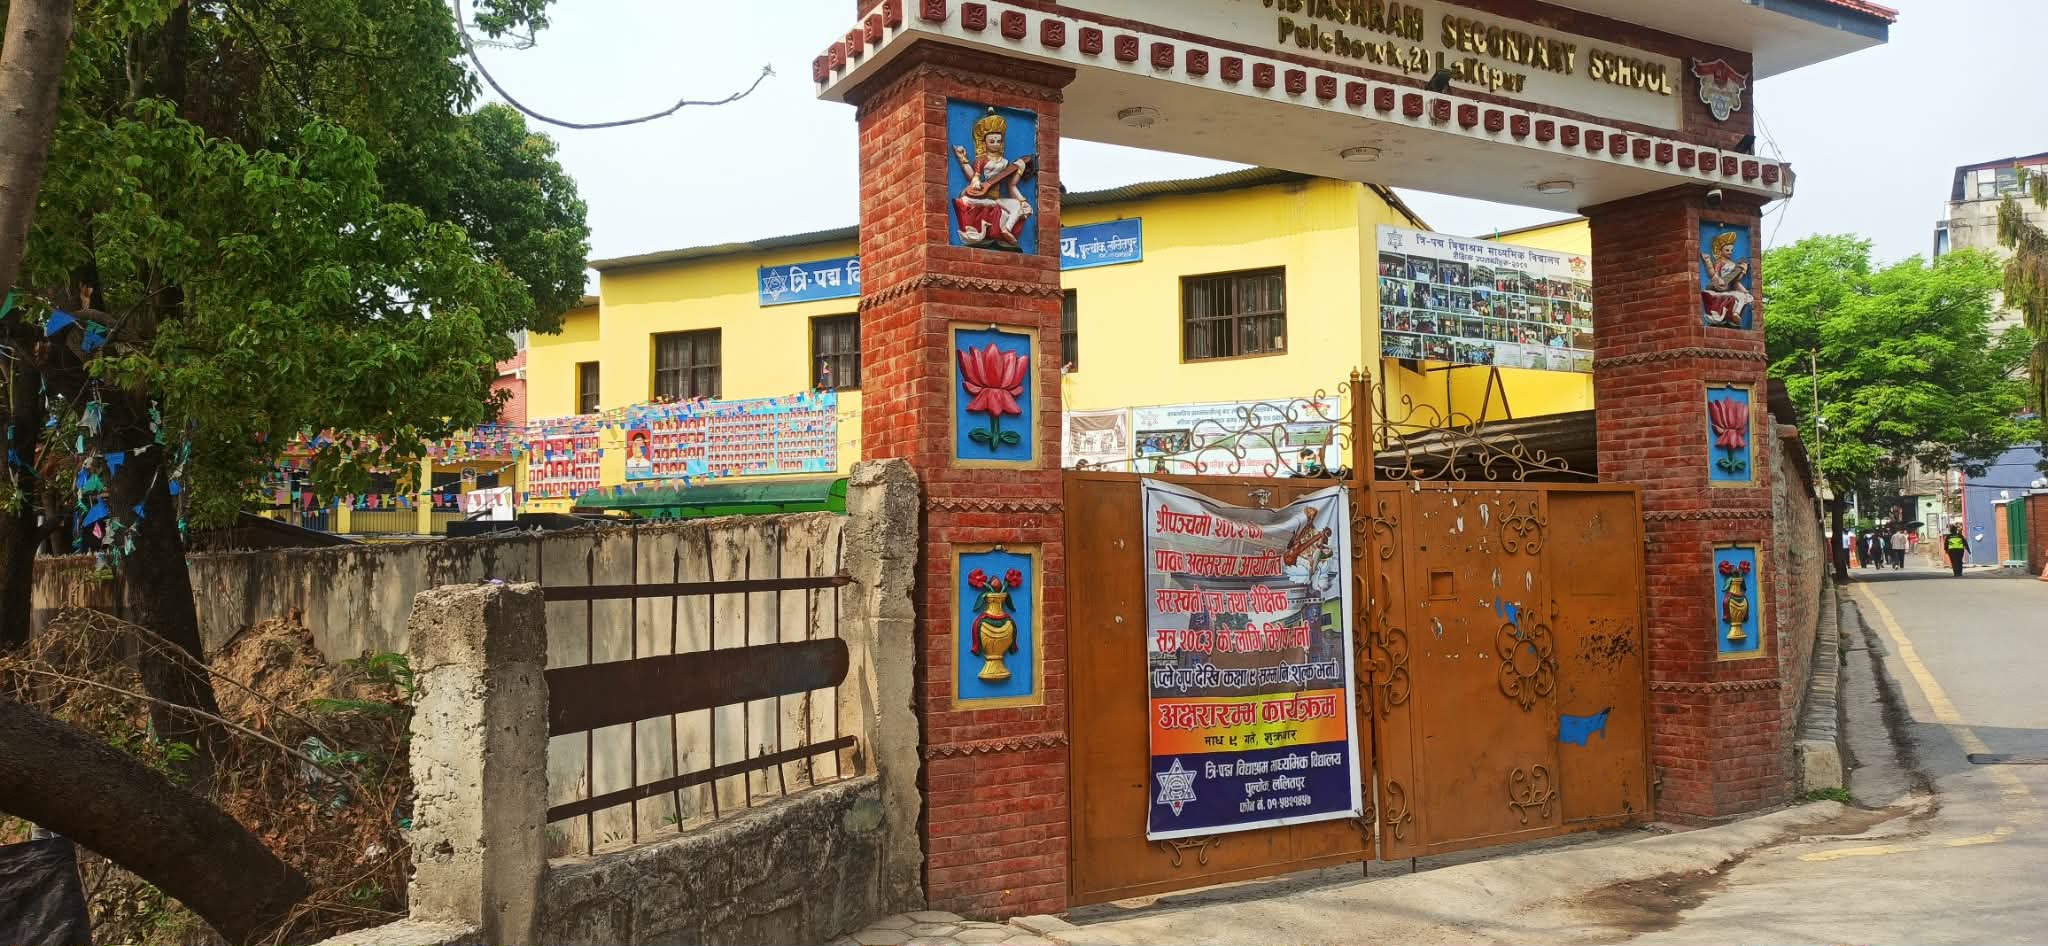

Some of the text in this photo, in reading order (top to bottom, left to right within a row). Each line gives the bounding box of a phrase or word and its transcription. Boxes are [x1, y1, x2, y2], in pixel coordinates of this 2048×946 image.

[1440, 14, 1576, 75] SECONDARY
[1588, 48, 1672, 95] SCHOOL
[1449, 239, 1483, 254] विद्याश्रम
[1488, 246, 1525, 261] माध्यमिक
[1529, 251, 1560, 266] विद्यालय
[790, 266, 841, 293] त्रि-पद्म
[1186, 553, 1238, 576] अवसरमा
[1239, 549, 1282, 576] आयोजित
[1156, 585, 1203, 613] सरस्वती
[1227, 591, 1248, 614] तथा
[1251, 584, 1288, 614] शैक्षिक
[1156, 629, 1176, 655] सत्र
[1180, 630, 1213, 654] २०८३
[1216, 623, 1233, 652] को
[1234, 623, 1262, 653] लागि
[1194, 663, 1220, 688] देखि
[1222, 667, 1248, 688] कक्षा
[1258, 667, 1279, 686] सम्म
[1158, 693, 1336, 731] अक्षरारम्भ कार्यक्रम
[1236, 758, 1269, 777] विद्याश्रम
[1270, 753, 1309, 773] माध्यमिक
[1310, 751, 1341, 769] विद्यालय
[1272, 774, 1306, 791] ललितपुर
[1239, 798, 1255, 812] फोन
